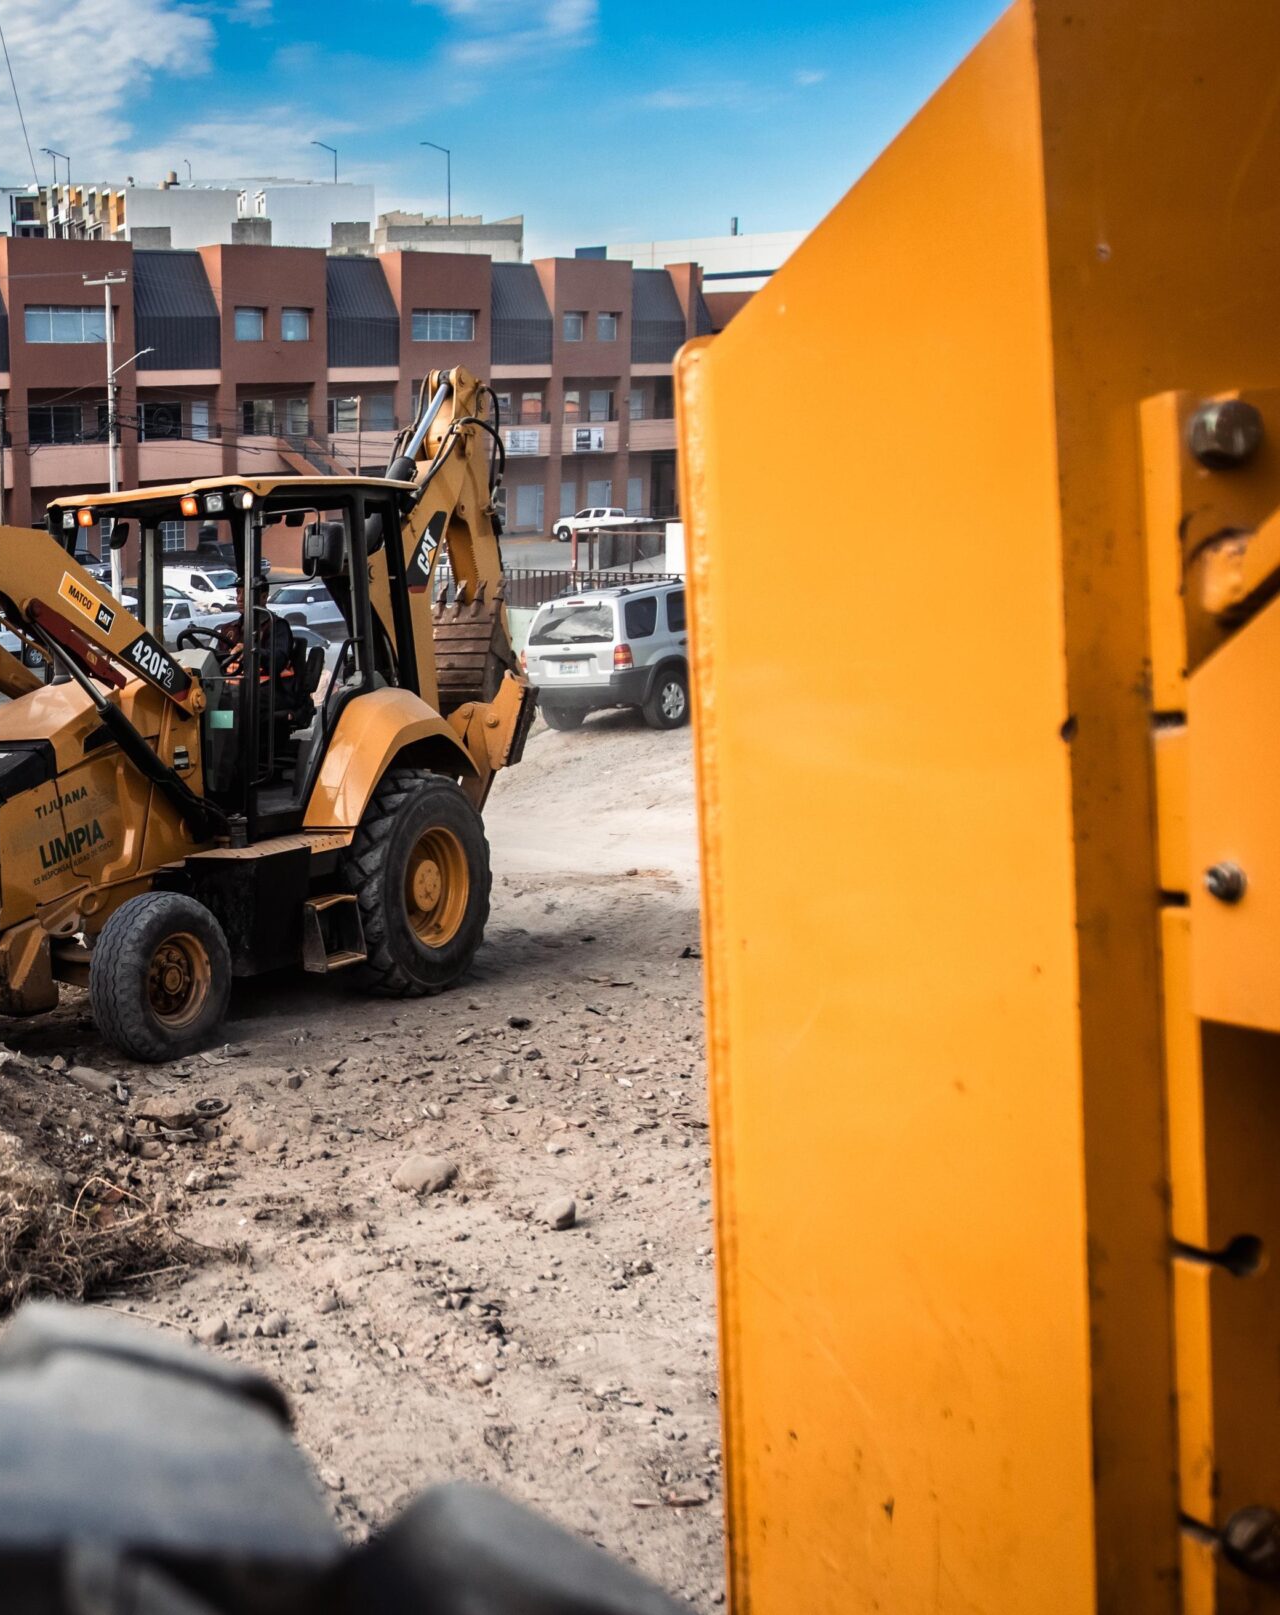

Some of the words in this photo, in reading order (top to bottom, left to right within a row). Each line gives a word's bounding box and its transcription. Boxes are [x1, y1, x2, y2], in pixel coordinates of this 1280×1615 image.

[417, 527, 438, 576] CAT
[68, 584, 93, 610] MATCO
[98, 609, 112, 626] CAT
[131, 640, 175, 688] 420F2
[34, 786, 88, 819] TIJUANA
[39, 819, 105, 870] LIMPIA
